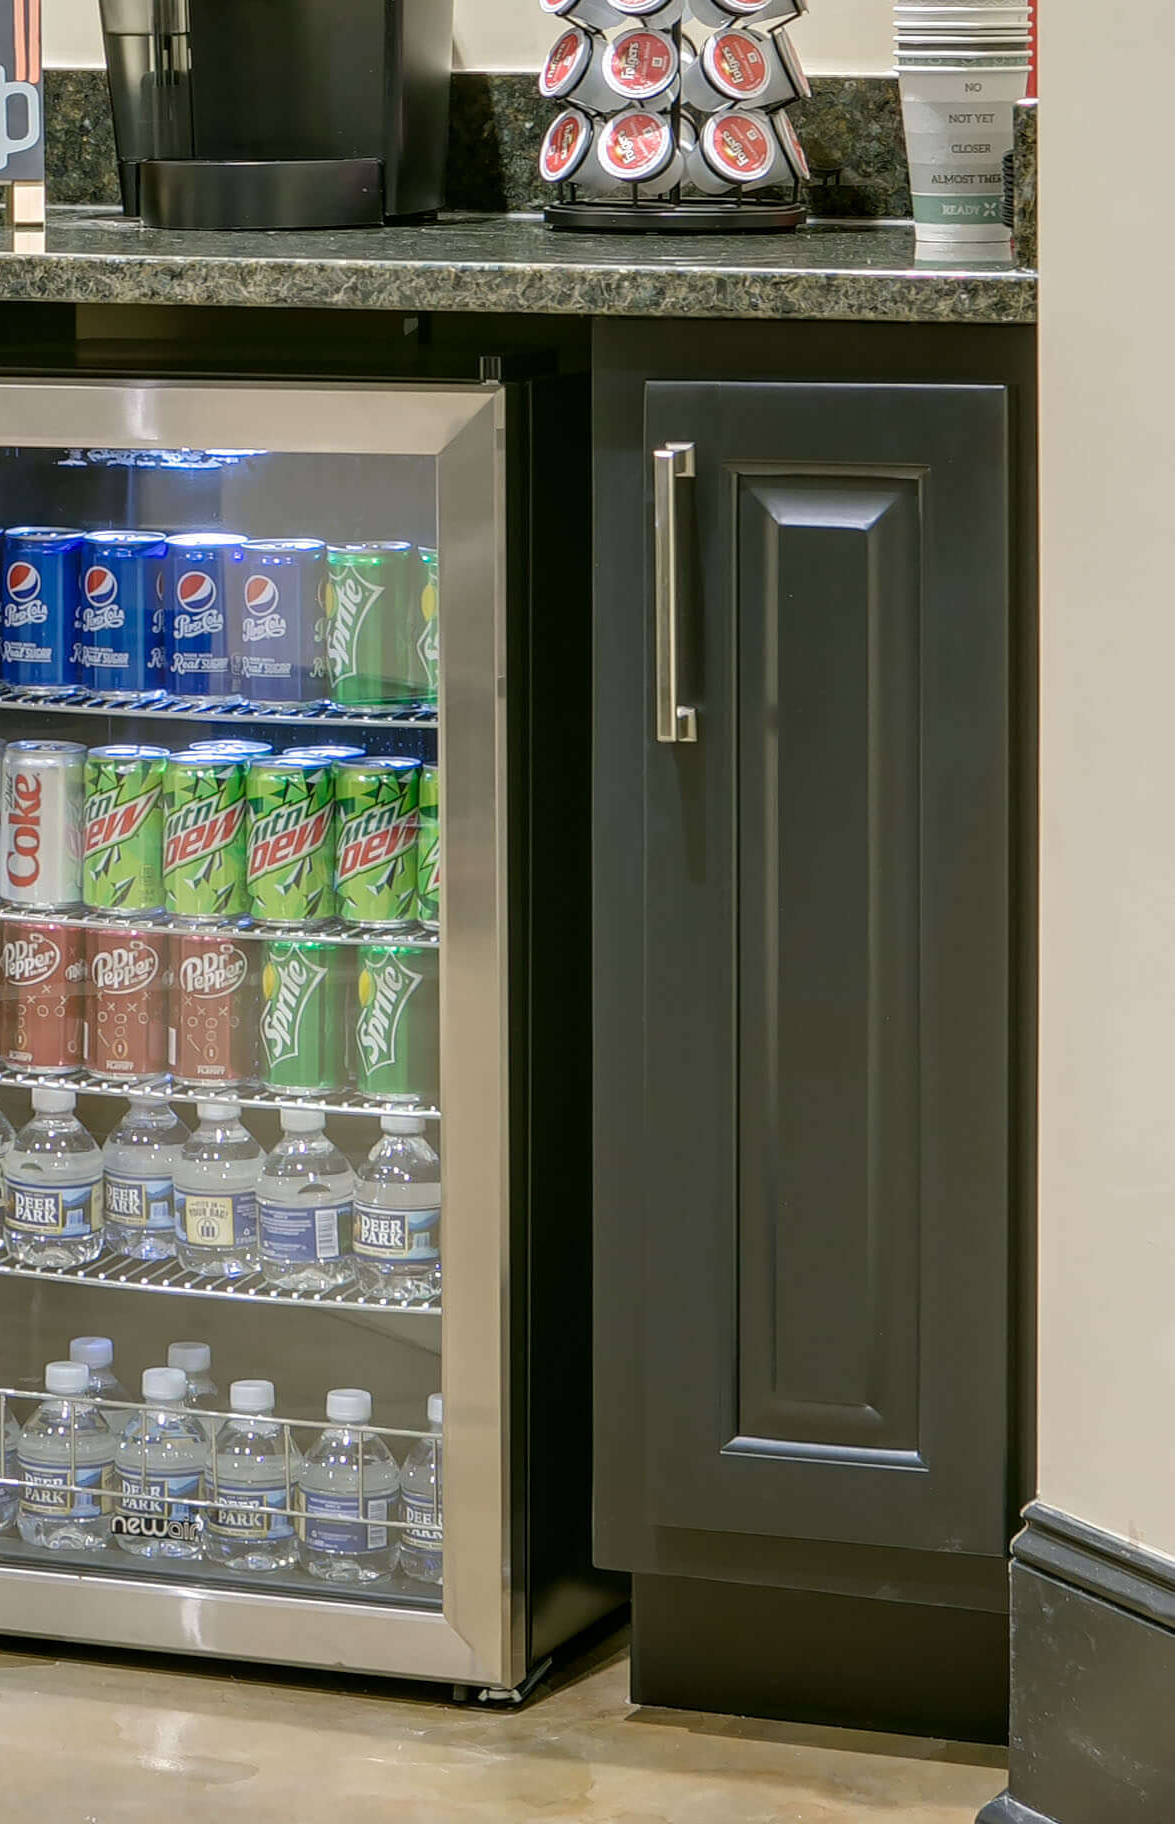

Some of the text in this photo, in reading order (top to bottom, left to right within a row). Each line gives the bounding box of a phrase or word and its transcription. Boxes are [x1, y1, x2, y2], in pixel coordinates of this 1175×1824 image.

[621, 41, 641, 80] Folgers
[723, 46, 744, 84] Folgers
[964, 82, 982, 94] NO
[948, 113, 995, 124] NOT YET
[723, 131, 750, 167] Folgers
[951, 142, 991, 154] CLOSER
[931, 173, 975, 185] ALMOST
[941, 202, 981, 216] READY
[86, 794, 113, 821] tn
[6, 773, 42, 887] Coke
[16, 934, 39, 955] Dr
[3, 942, 56, 980] Pepper
[112, 948, 138, 968] Dr
[203, 950, 230, 973] Dr
[92, 951, 156, 989] Pepper
[181, 957, 244, 993] Pepper
[264, 959, 308, 1058] Sprite
[359, 965, 403, 1065] Sprite
[15, 1191, 57, 1213] DEER
[15, 1207, 58, 1224] PARK
[361, 1214, 403, 1234] DEER
[361, 1229, 403, 1248] PARK
[25, 1486, 66, 1504] PARK
[122, 1497, 163, 1513] PARK
[218, 1510, 262, 1527] PARK
